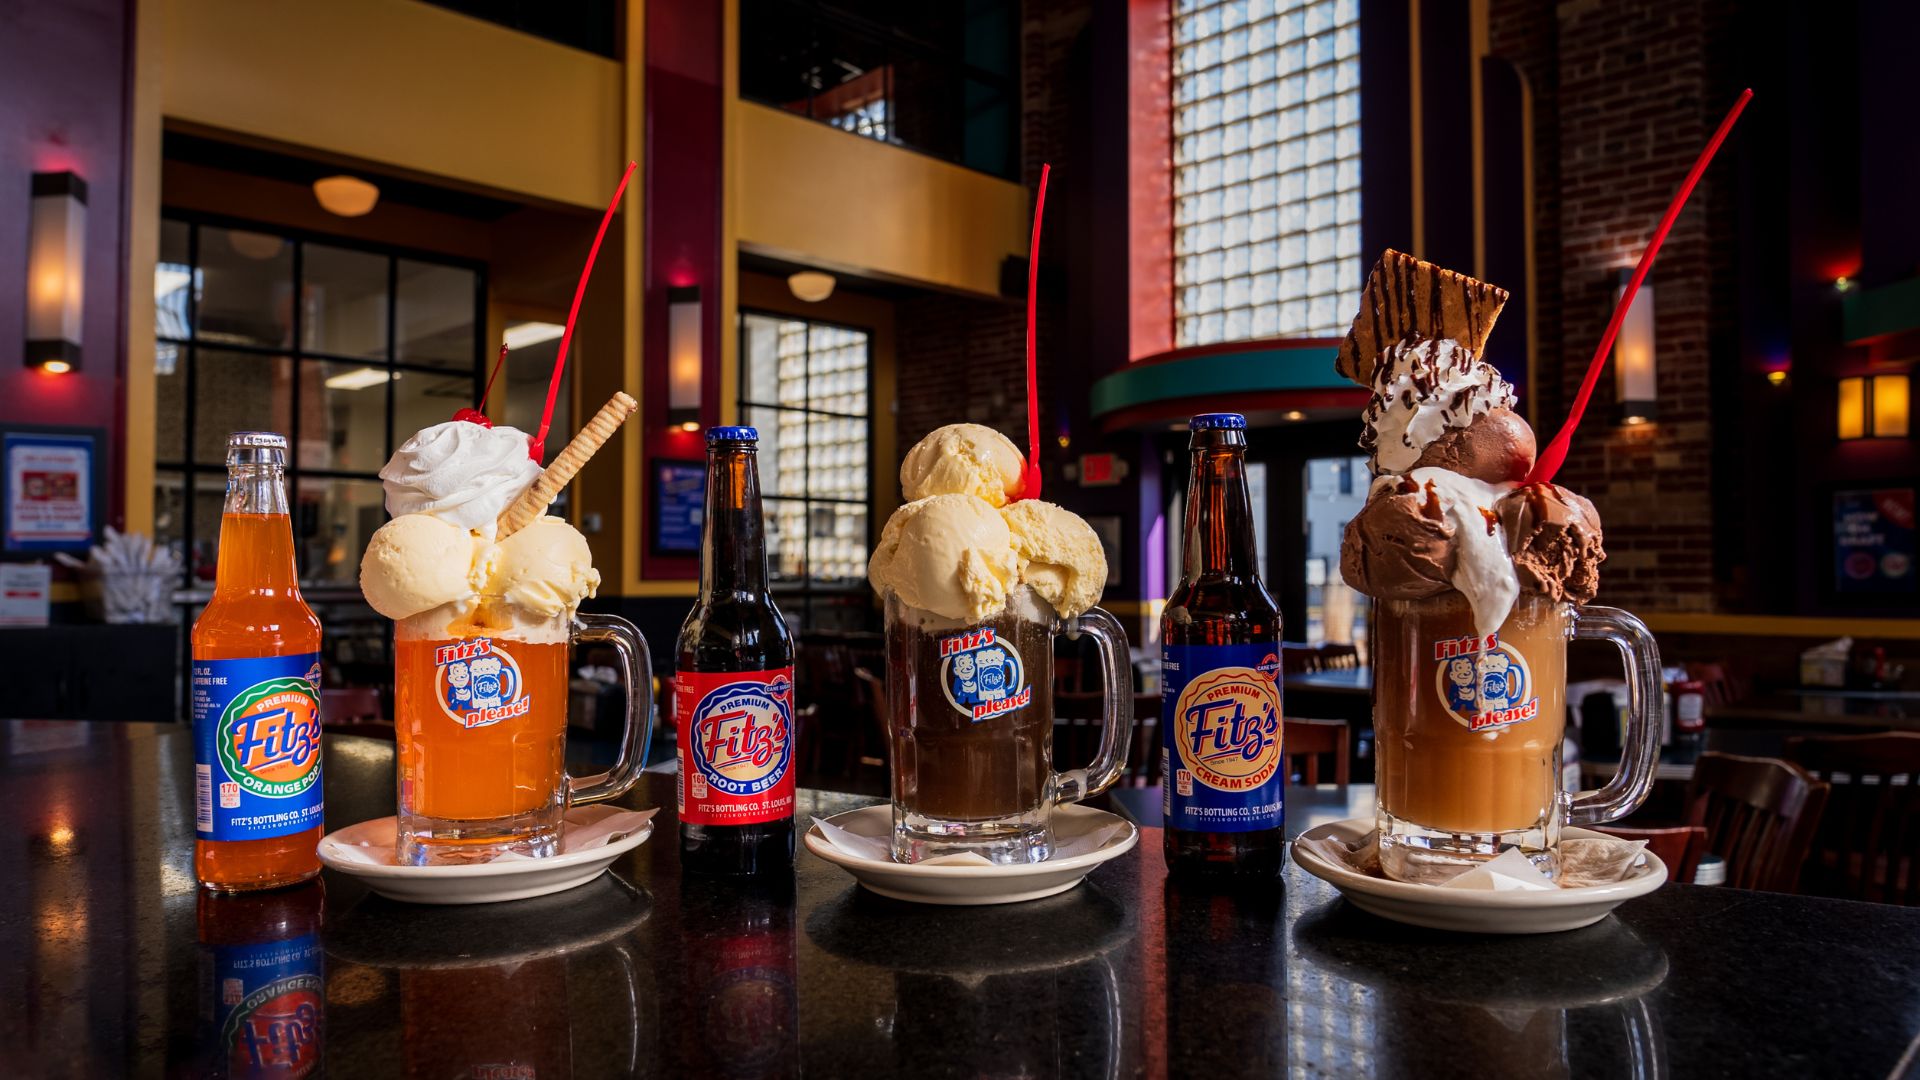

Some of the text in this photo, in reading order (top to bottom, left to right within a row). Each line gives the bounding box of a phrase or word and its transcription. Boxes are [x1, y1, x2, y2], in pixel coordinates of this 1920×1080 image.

[436, 638, 491, 666] Fitz's
[941, 629, 995, 657] Fitz's
[1435, 634, 1497, 660] Fitzs
[213, 677, 228, 685] FREE
[1206, 685, 1260, 701] PREMIUM
[256, 694, 309, 712] PREMIUM
[466, 695, 530, 728] please!
[720, 699, 770, 713] PREMIUM
[973, 687, 1031, 720] please!
[1470, 698, 1538, 730] please!
[230, 707, 321, 767] Fitz's
[700, 710, 788, 766] Fitz's
[1185, 698, 1279, 761] Fitz's
[243, 765, 319, 795] ORANGE POP
[692, 774, 705, 784] 160
[708, 768, 784, 793] ROOT BEER
[1178, 770, 1191, 781] 170
[1195, 763, 1275, 789] CREAM SODA
[221, 783, 237, 794] 170
[231, 817, 252, 826] FITZ'S
[253, 813, 288, 825] BOTTLING
[289, 811, 299, 820] CO.
[301, 808, 309, 817] ST.
[698, 804, 715, 812] FITZ'S
[715, 803, 748, 813] BOTTLING
[748, 802, 759, 811] CO.
[762, 801, 771, 810] ST.
[1185, 806, 1203, 815] FITZ'S
[1204, 807, 1238, 817] BOTTLING
[1239, 807, 1250, 816] CO.
[1252, 806, 1261, 815] ST.
